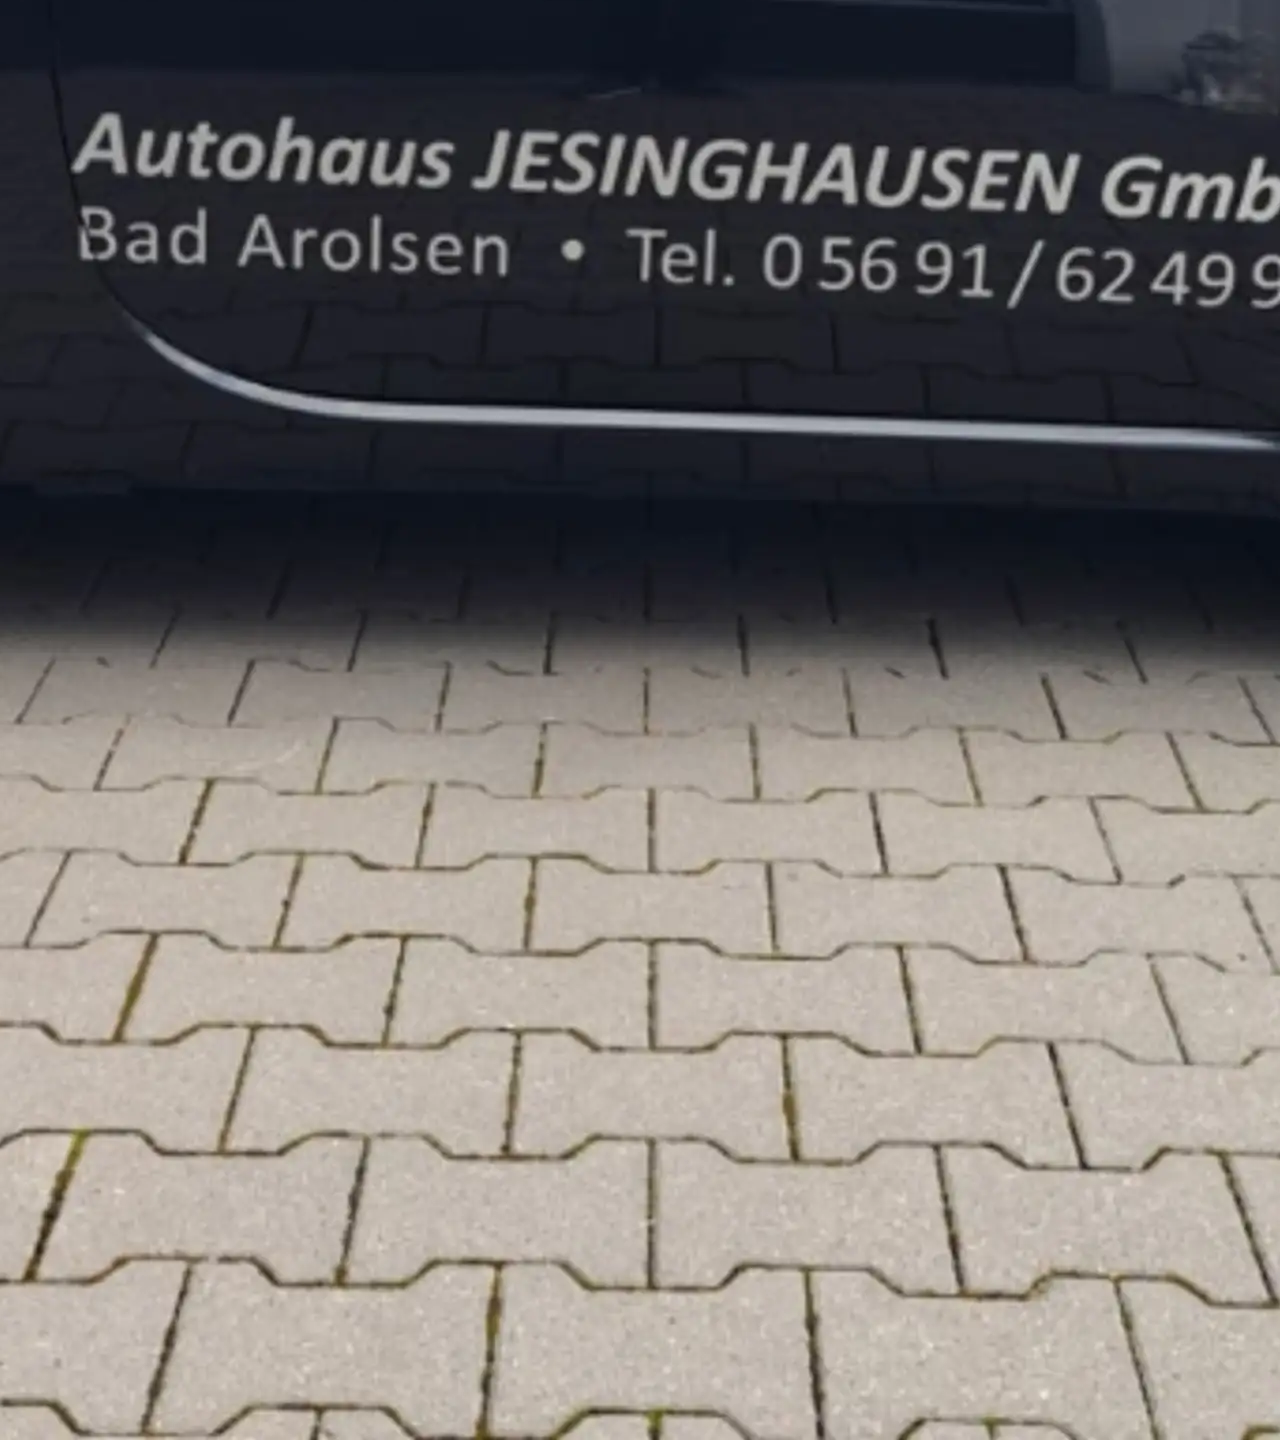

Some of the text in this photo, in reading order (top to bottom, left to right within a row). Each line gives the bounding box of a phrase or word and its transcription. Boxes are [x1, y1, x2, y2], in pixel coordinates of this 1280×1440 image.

[71, 111, 455, 189] Autohaus
[471, 129, 1082, 214] JESINGHAUSEN
[79, 206, 207, 265] Bad
[237, 213, 508, 277] Arolsen
[626, 227, 736, 286] Tel.
